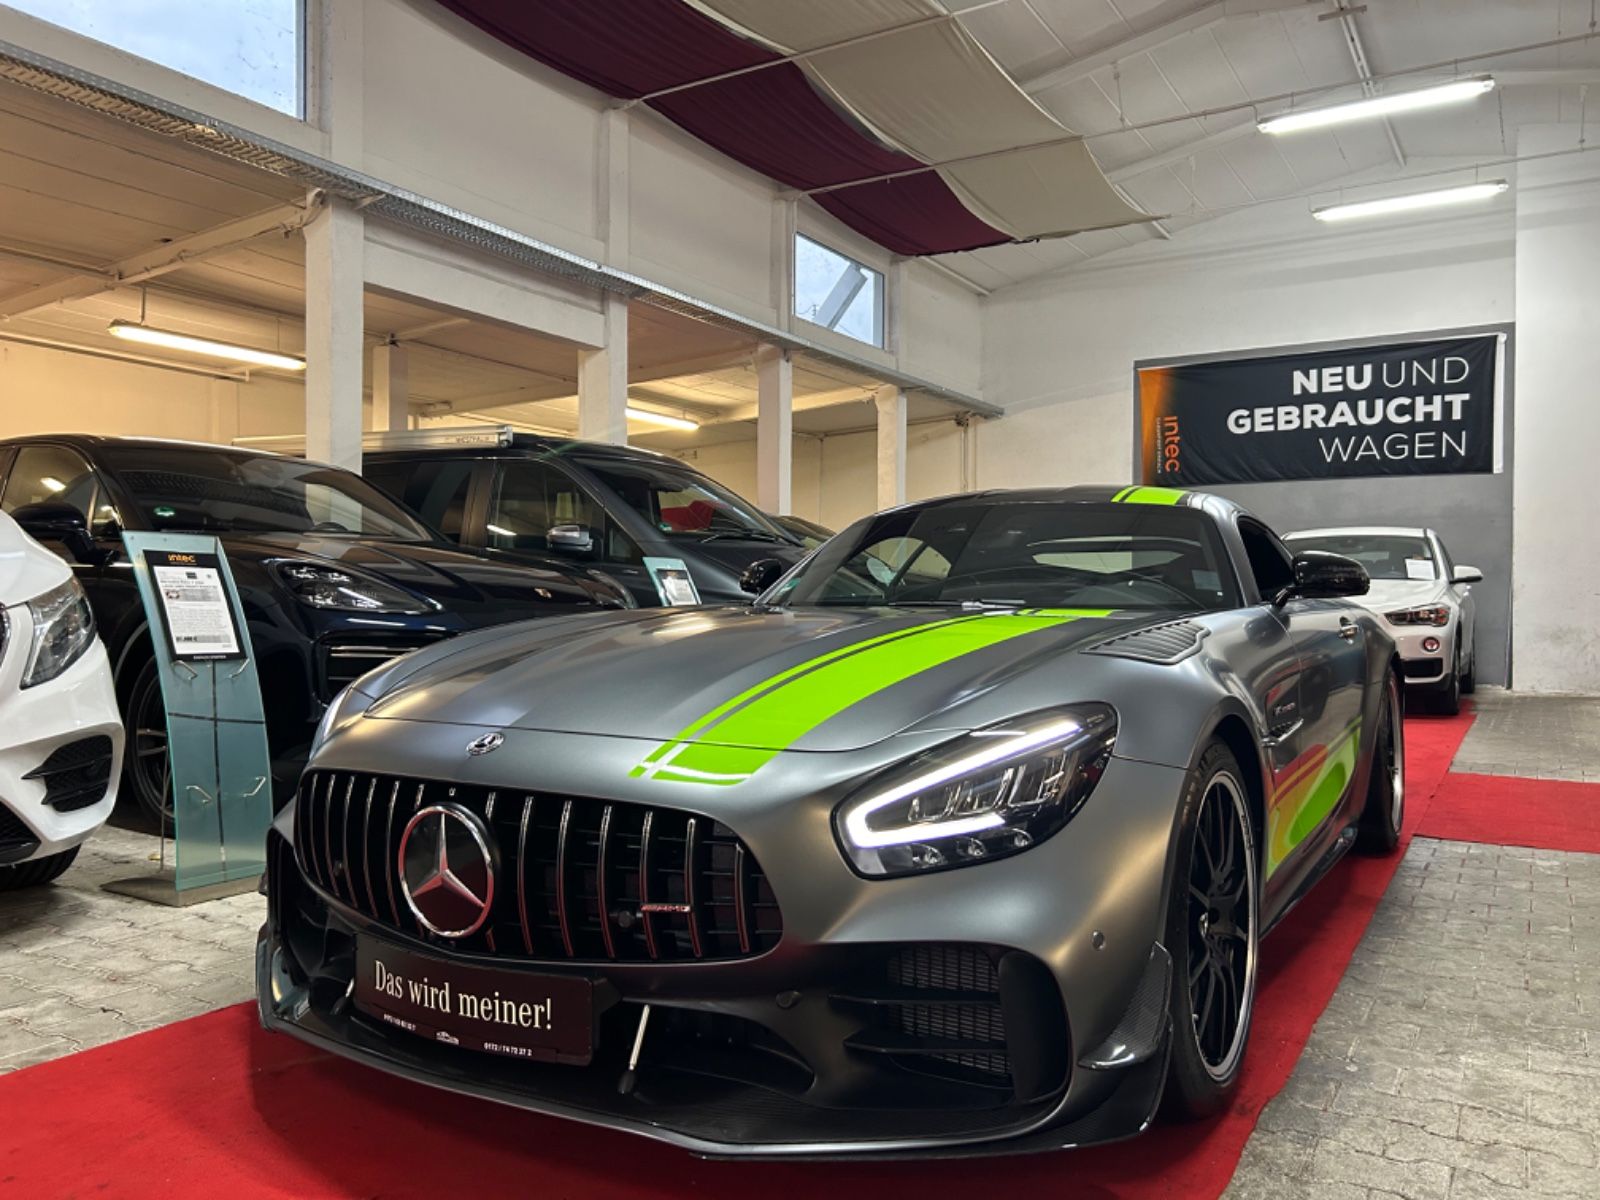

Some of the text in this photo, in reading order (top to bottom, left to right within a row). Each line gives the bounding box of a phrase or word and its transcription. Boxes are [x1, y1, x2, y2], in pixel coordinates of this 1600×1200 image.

[1292, 356, 1470, 396] NEU UND
[1226, 393, 1471, 435] GEBRAUCHT
[1318, 430, 1467, 463] WAGEN
[375, 960, 403, 999] Das
[408, 977, 451, 1013] wird
[458, 991, 552, 1030] meiner!
